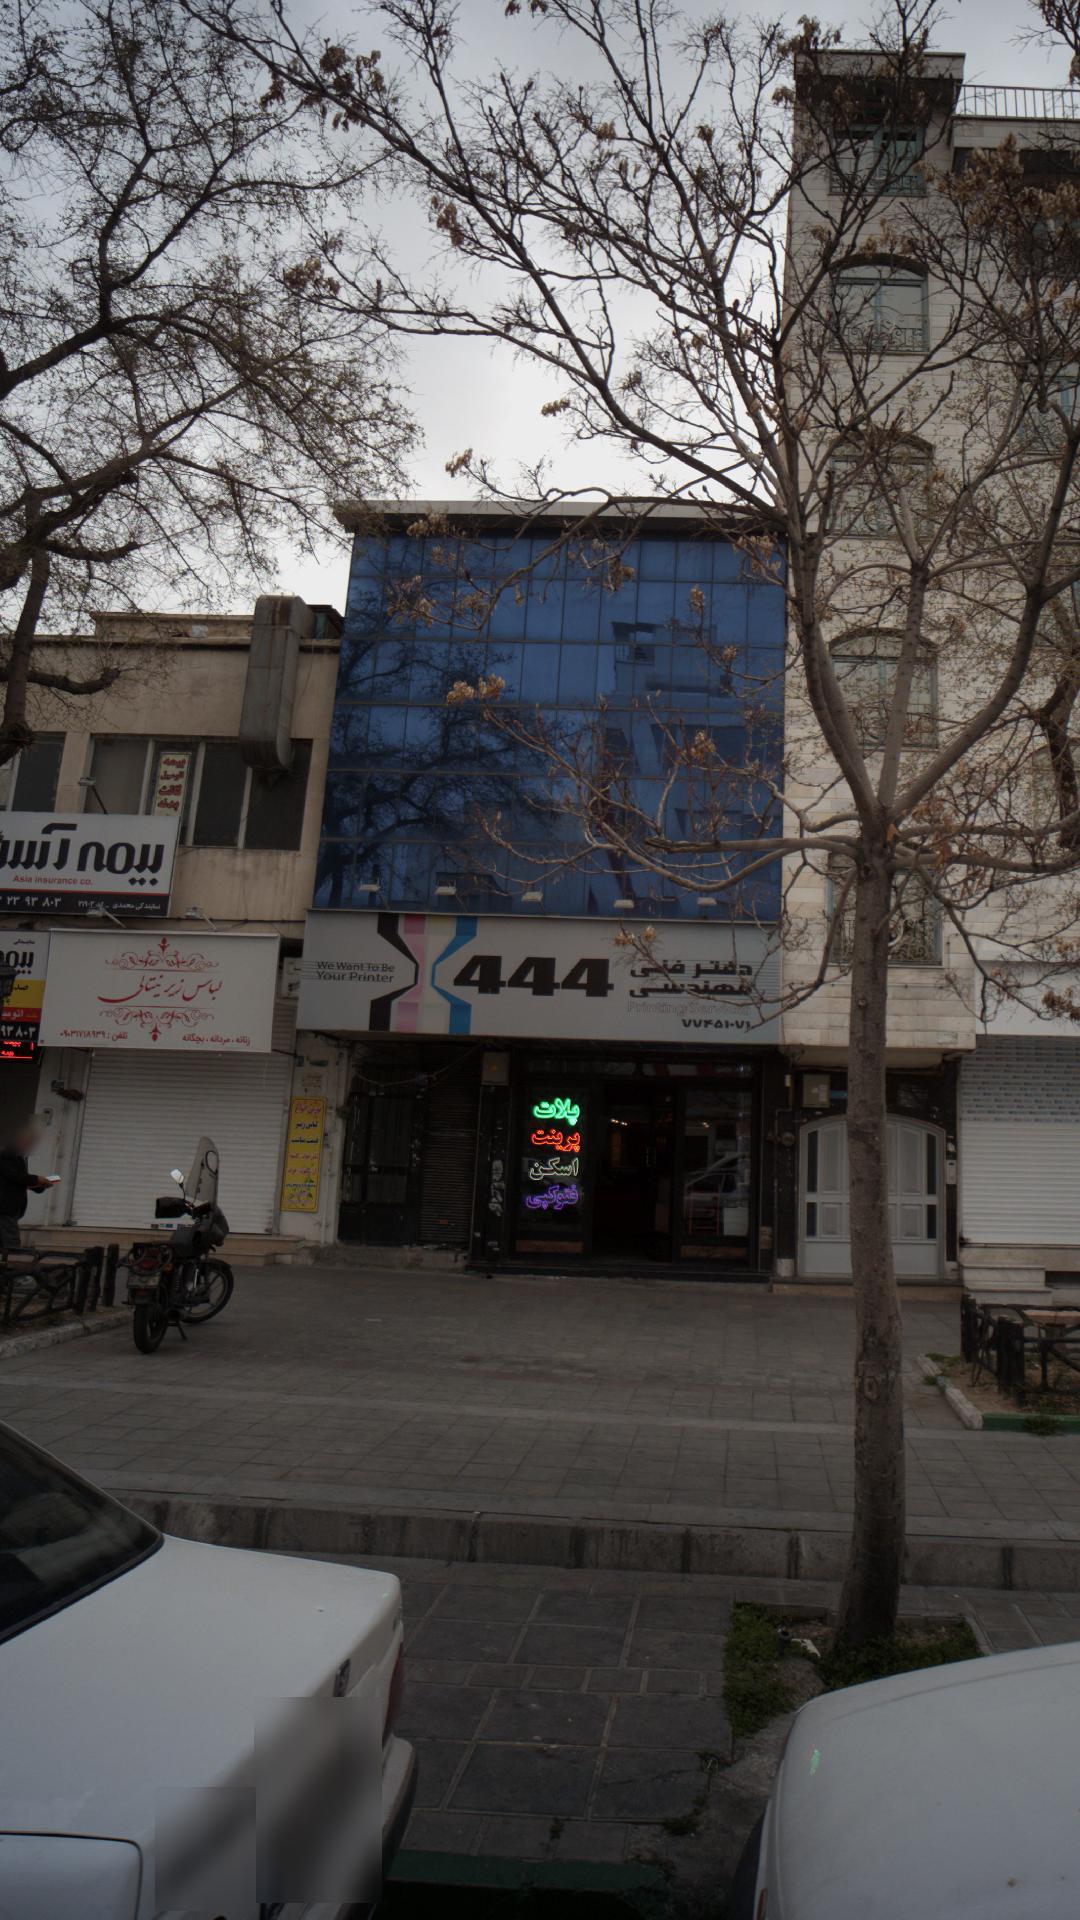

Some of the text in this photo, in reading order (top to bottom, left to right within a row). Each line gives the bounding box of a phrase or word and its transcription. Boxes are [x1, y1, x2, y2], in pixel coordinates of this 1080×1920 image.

[77, 841, 165, 886] بیمه
[13, 875, 33, 883] Asia
[34, 876, 79, 885] insurance
[317, 961, 395, 972] We Want To Be
[317, 971, 394, 982] Your Printer
[453, 955, 614, 998] 444
[630, 960, 752, 979] دفتر فنی
[164, 979, 184, 998] زیر
[183, 979, 222, 1002] لباس
[630, 981, 752, 998] مهندسی
[533, 1097, 580, 1126] پلات
[531, 1129, 581, 1152] پرینت
[529, 1157, 579, 1181] اسکن
[525, 1184, 579, 1211] فتوکپی
